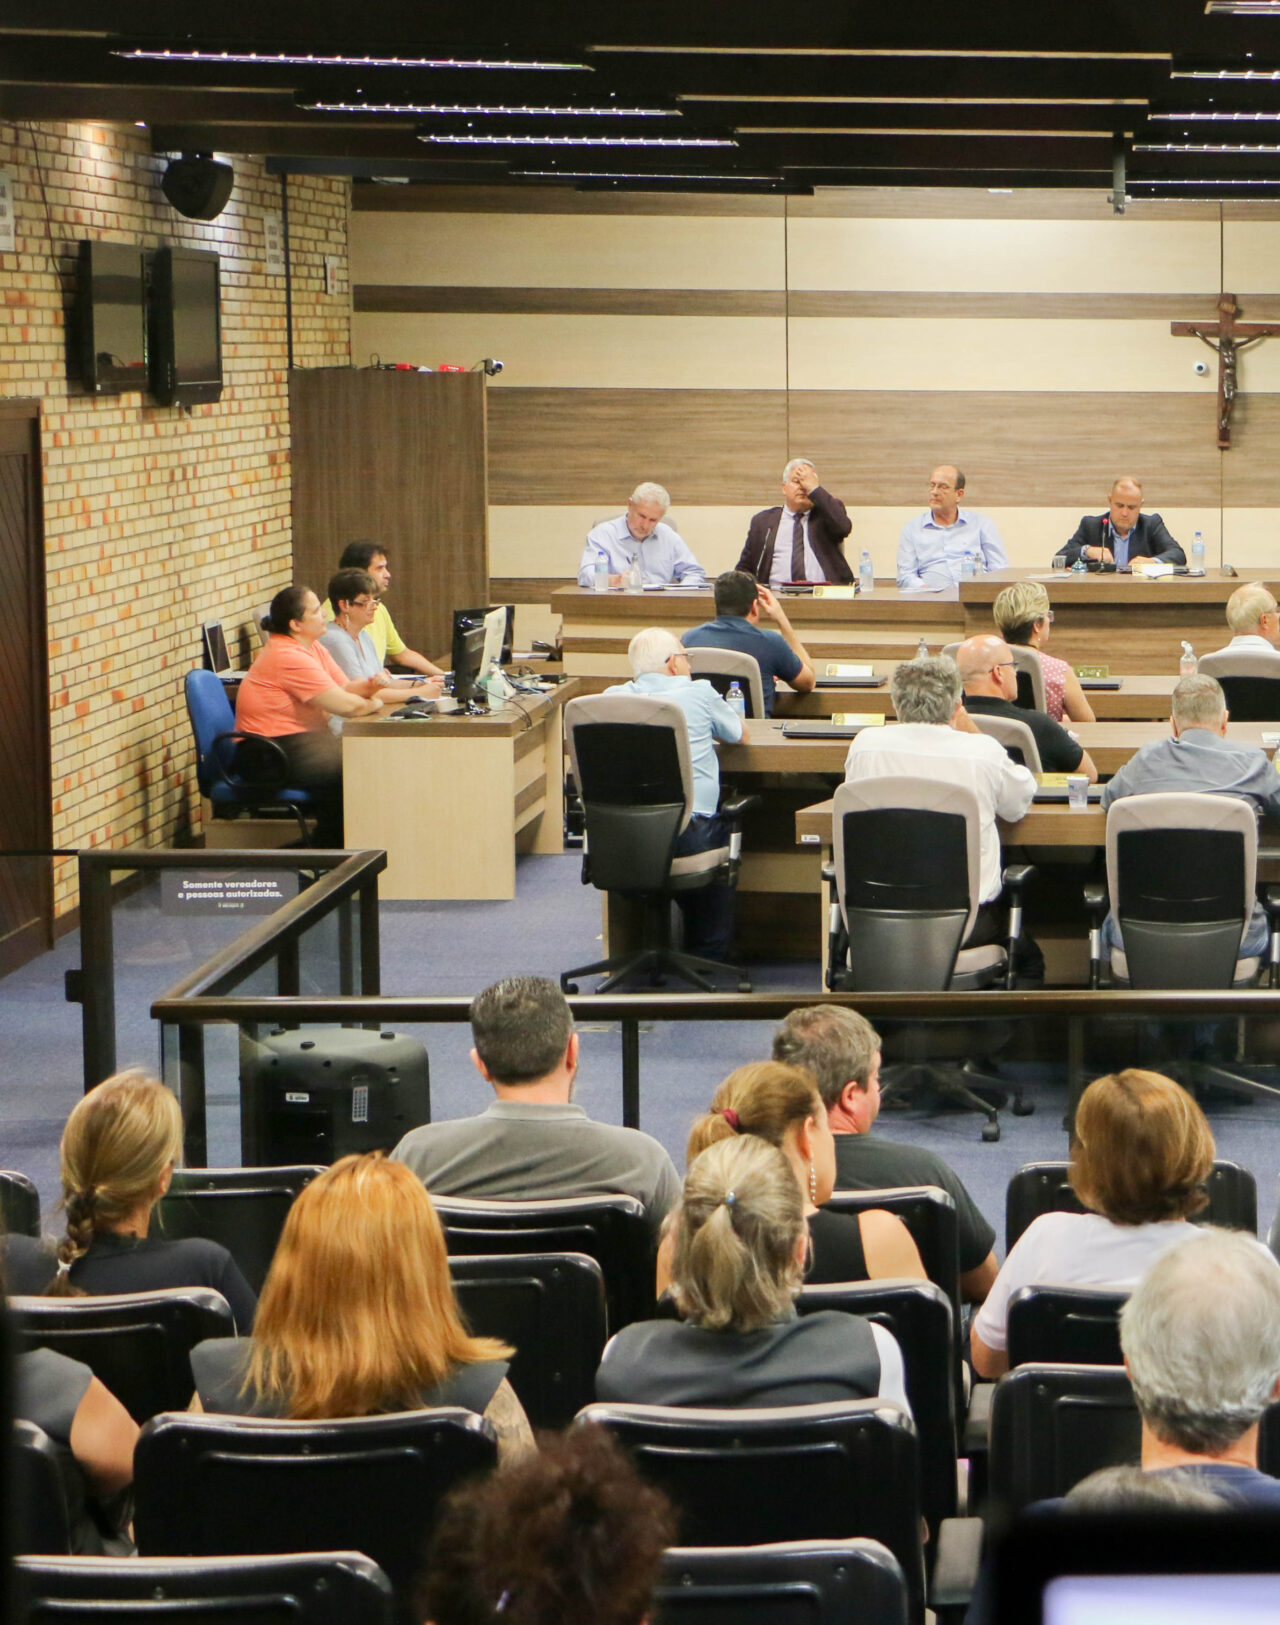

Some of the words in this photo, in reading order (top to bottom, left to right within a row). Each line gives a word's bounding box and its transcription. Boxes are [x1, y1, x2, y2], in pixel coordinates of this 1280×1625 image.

[182, 881, 223, 889] Somente
[225, 880, 277, 888] vereadores
[186, 892, 223, 900] pessoas
[226, 889, 283, 898] autorizadas.
